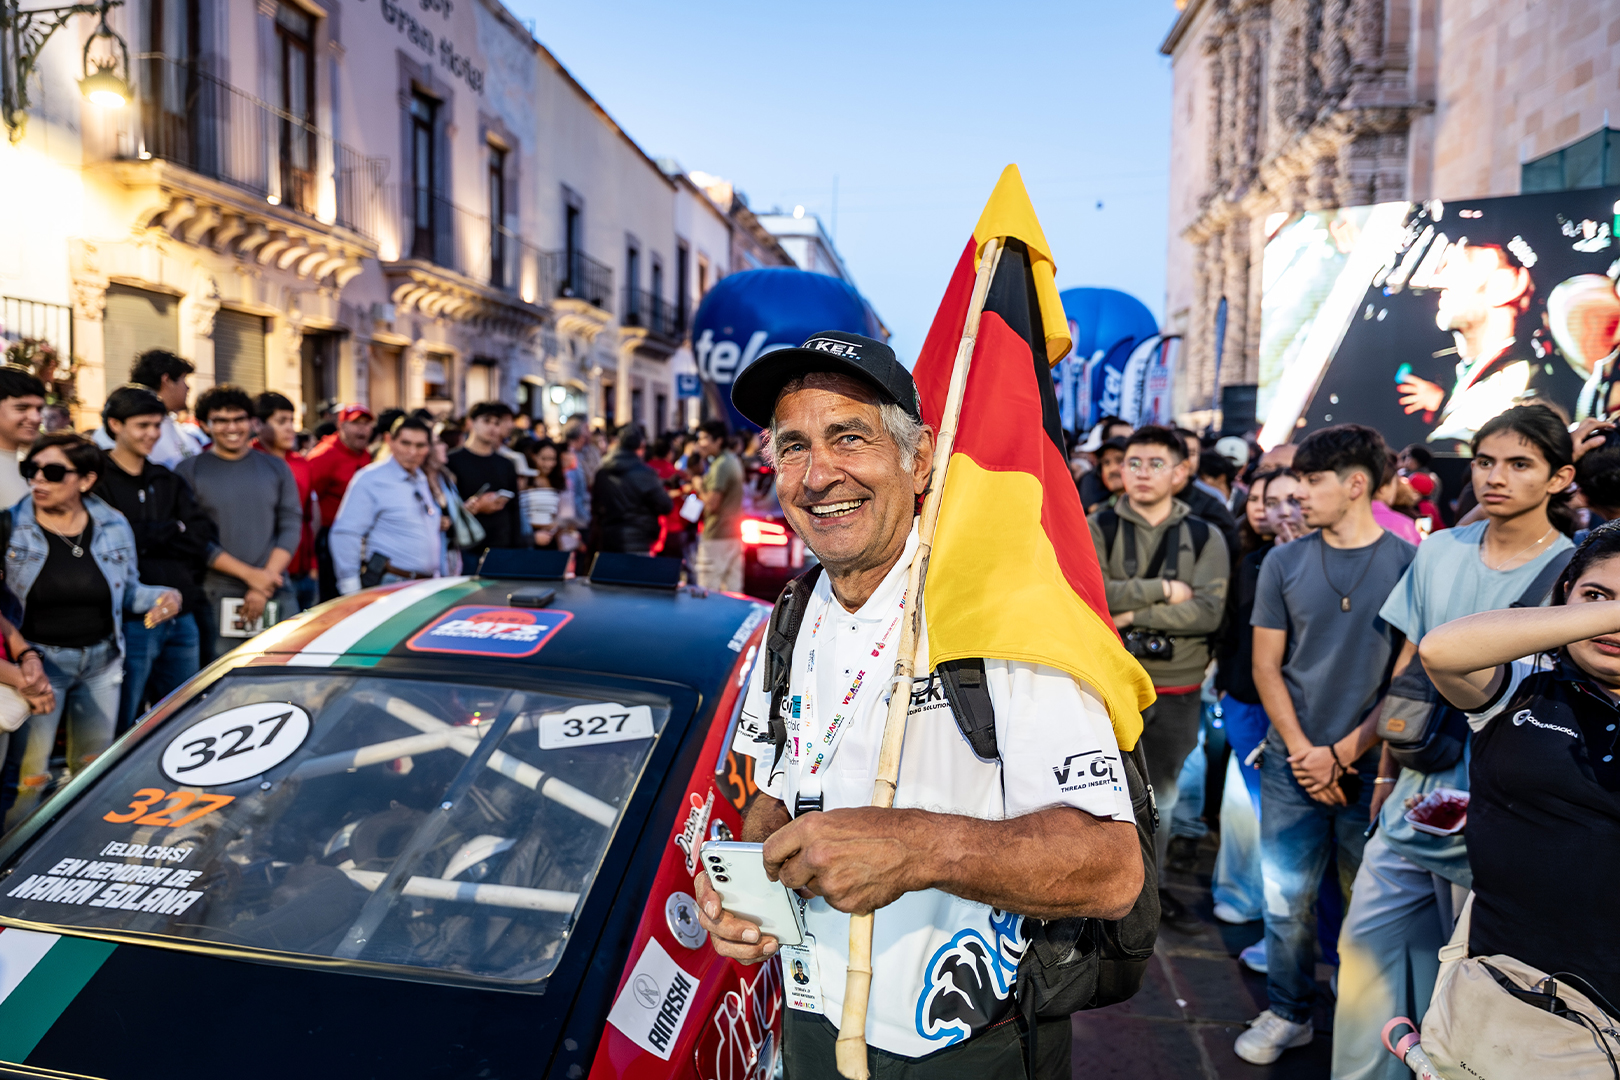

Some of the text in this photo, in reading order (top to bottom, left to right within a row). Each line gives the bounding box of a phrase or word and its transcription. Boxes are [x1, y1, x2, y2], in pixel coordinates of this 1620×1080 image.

[440, 36, 484, 95] Hotel
[695, 329, 792, 384] tel
[842, 670, 866, 705] VERACRUZ
[177, 710, 294, 774] 327
[563, 713, 631, 738] 327
[823, 713, 842, 744] CHIAPAS
[1061, 779, 1111, 793] THREAD INSERT
[103, 788, 236, 828] 327
[48, 858, 203, 888] EN MEMORIA DE
[89, 882, 204, 916] SOLANA
